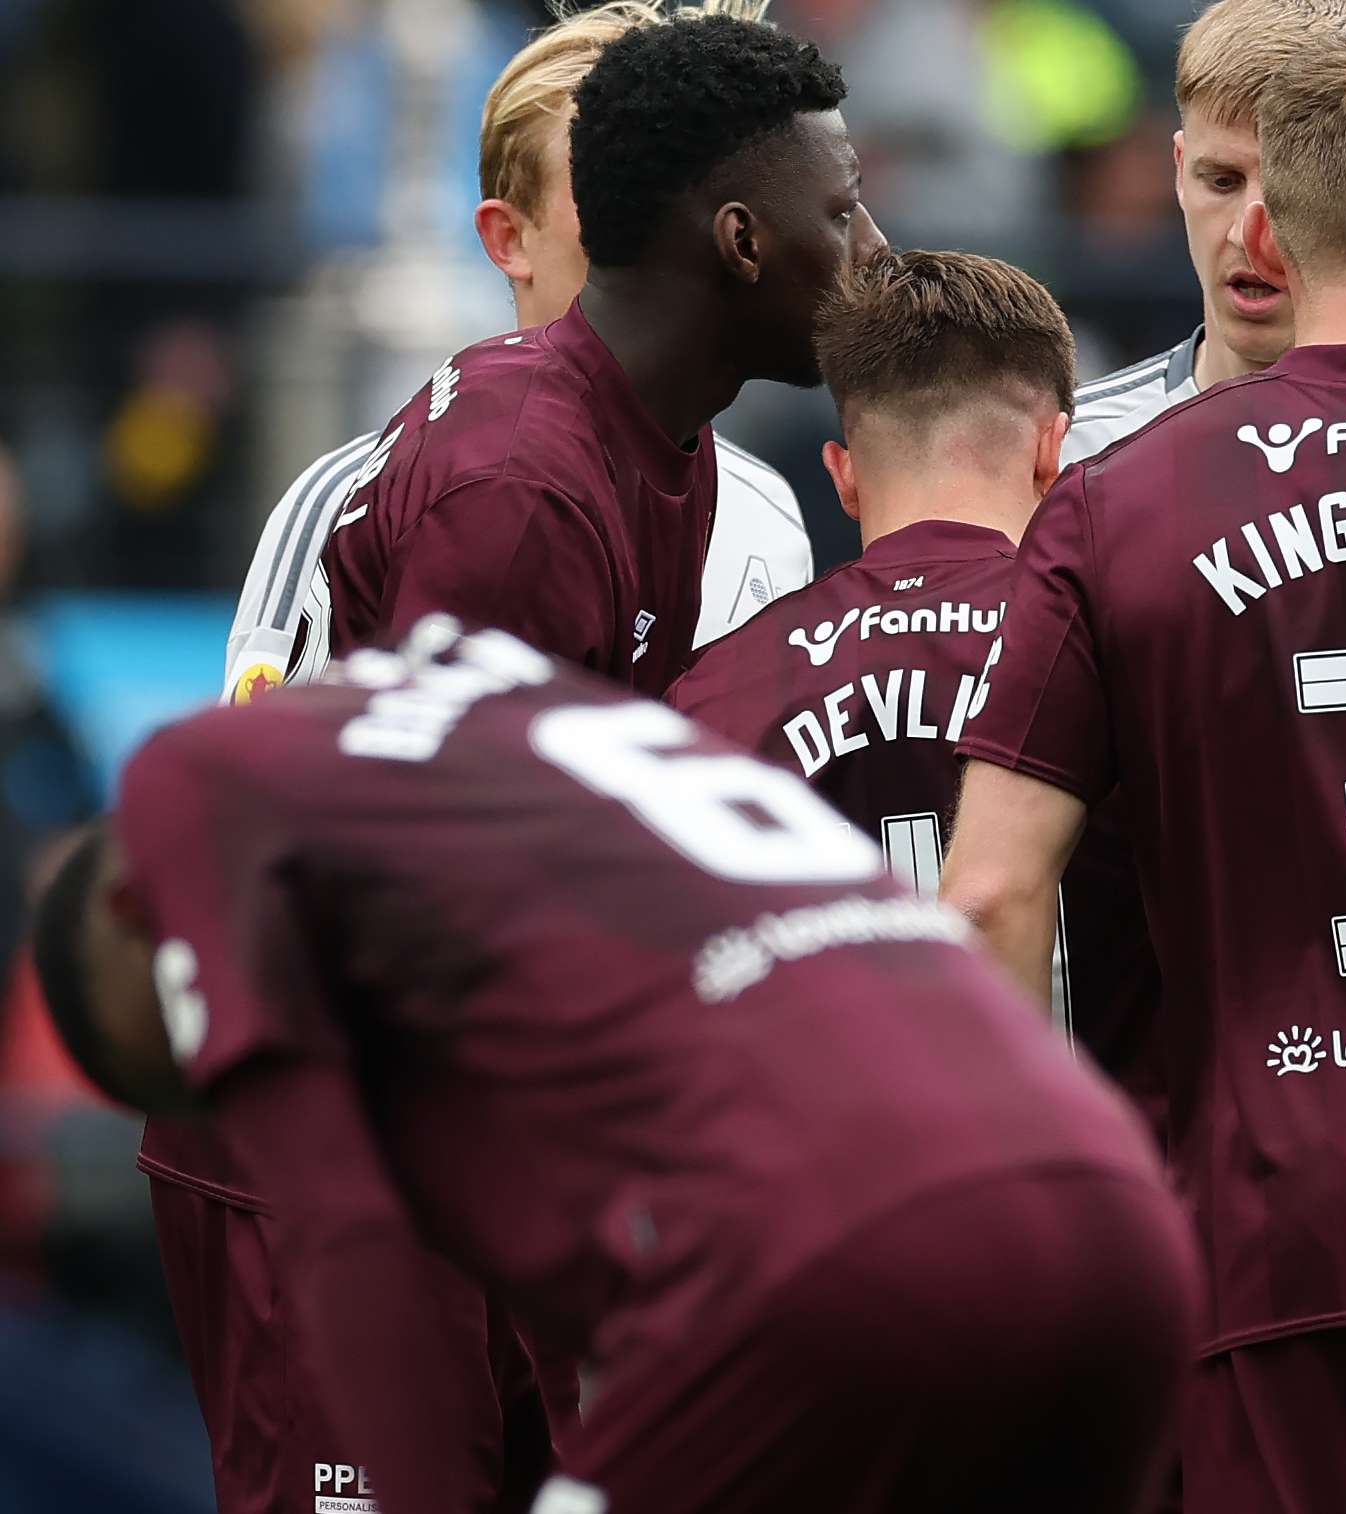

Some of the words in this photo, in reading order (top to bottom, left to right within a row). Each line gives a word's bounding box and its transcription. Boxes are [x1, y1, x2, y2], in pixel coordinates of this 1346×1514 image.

[892, 575, 924, 591] 1874
[860, 601, 1006, 641] FanHu
[782, 668, 977, 779] DEVLI
[527, 701, 884, 884] 6
